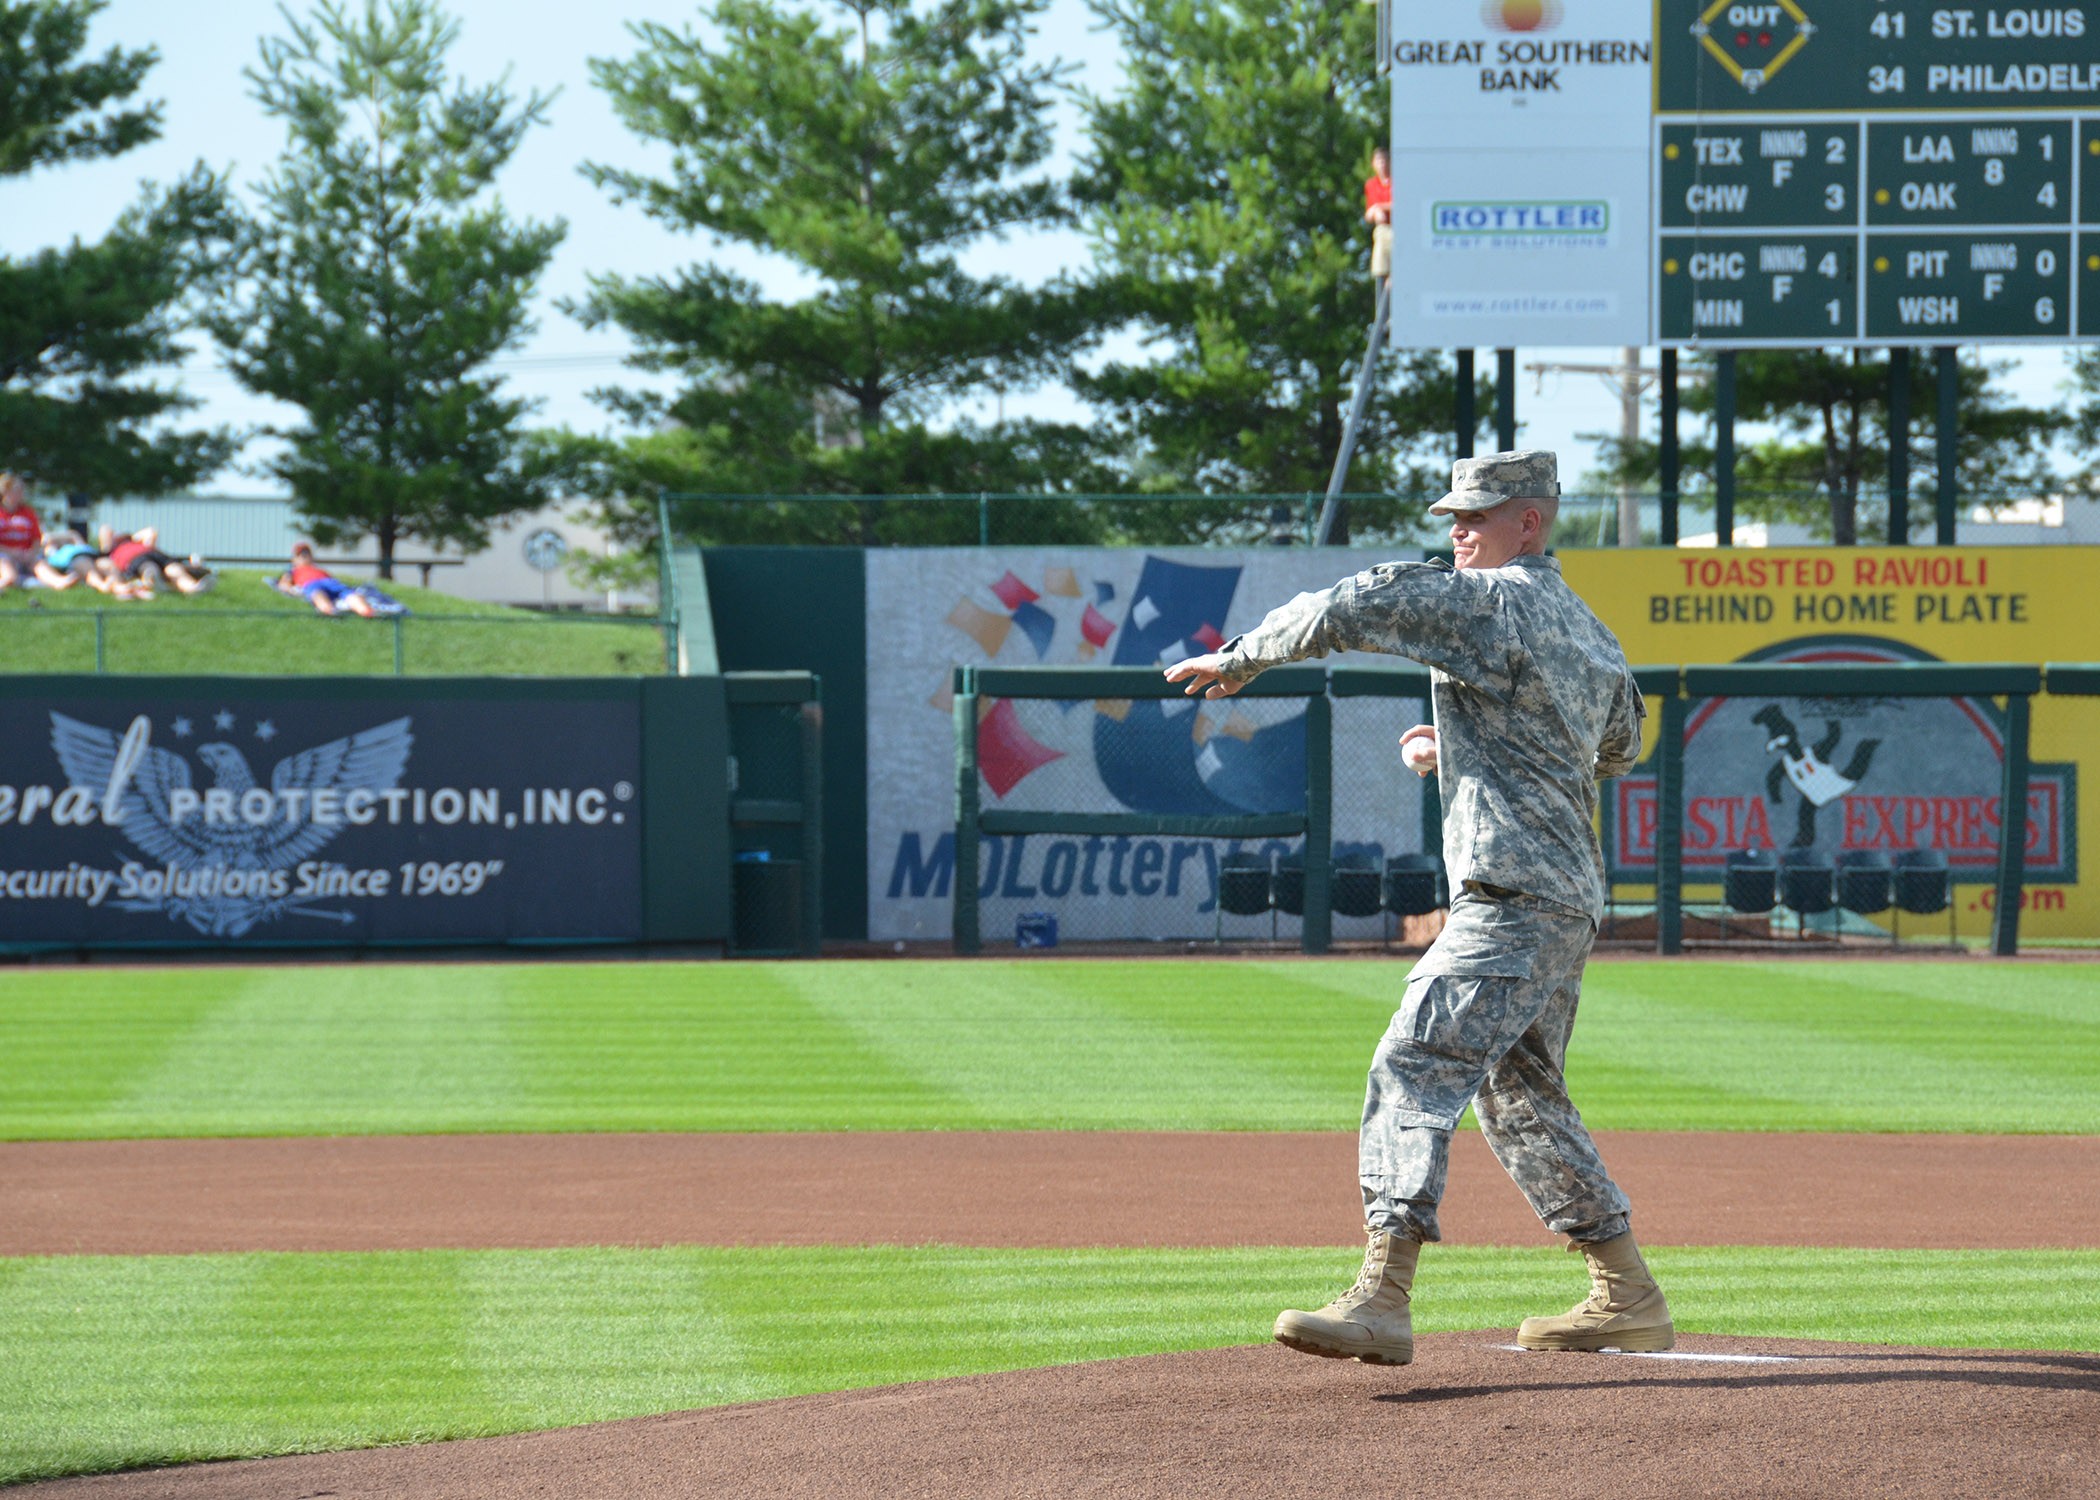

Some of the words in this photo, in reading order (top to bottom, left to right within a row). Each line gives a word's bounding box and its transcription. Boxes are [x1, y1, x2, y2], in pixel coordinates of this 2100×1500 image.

[1728, 5, 1782, 27] OUT
[1870, 11, 1906, 39] 41
[1931, 9, 1978, 38] ST.
[1987, 8, 2086, 38] LOUIS
[1394, 40, 1485, 65] GREAT
[1497, 40, 1651, 65] SOUTHERN
[1480, 68, 1561, 92] BANK
[1868, 65, 1905, 93] 34
[1693, 137, 1743, 165] TEX
[1826, 136, 1846, 164] 2
[1903, 135, 1955, 163] LAA
[2038, 134, 2053, 161] 1
[1772, 160, 1793, 187] F
[1984, 158, 2005, 186] 8
[1686, 184, 1748, 213] CHW
[1825, 183, 1845, 211] 3
[1900, 182, 1957, 210] OAK
[2036, 181, 2057, 209] 4
[1440, 207, 1601, 228] ROTTLER
[1688, 252, 1745, 280] CHC
[1818, 251, 1838, 279] 4
[1907, 250, 1949, 278] PIT
[2036, 249, 2056, 277] 0
[1772, 275, 1793, 303] F
[1983, 273, 2004, 300] F
[1694, 299, 1743, 326] MIN
[1825, 298, 1841, 325] 1
[1898, 296, 1959, 324] WSH
[2035, 296, 2055, 324] 6
[1680, 558, 1834, 587] TOASTED
[1855, 557, 1987, 586] RAVIOLI
[1650, 595, 1774, 623] BEHIND
[1794, 595, 1897, 622] HOME
[1915, 594, 2028, 622] PLATE
[1635, 795, 1776, 850] PSTA
[0, 861, 114, 907] curity
[118, 860, 290, 898] Solutions
[293, 860, 391, 897] Since
